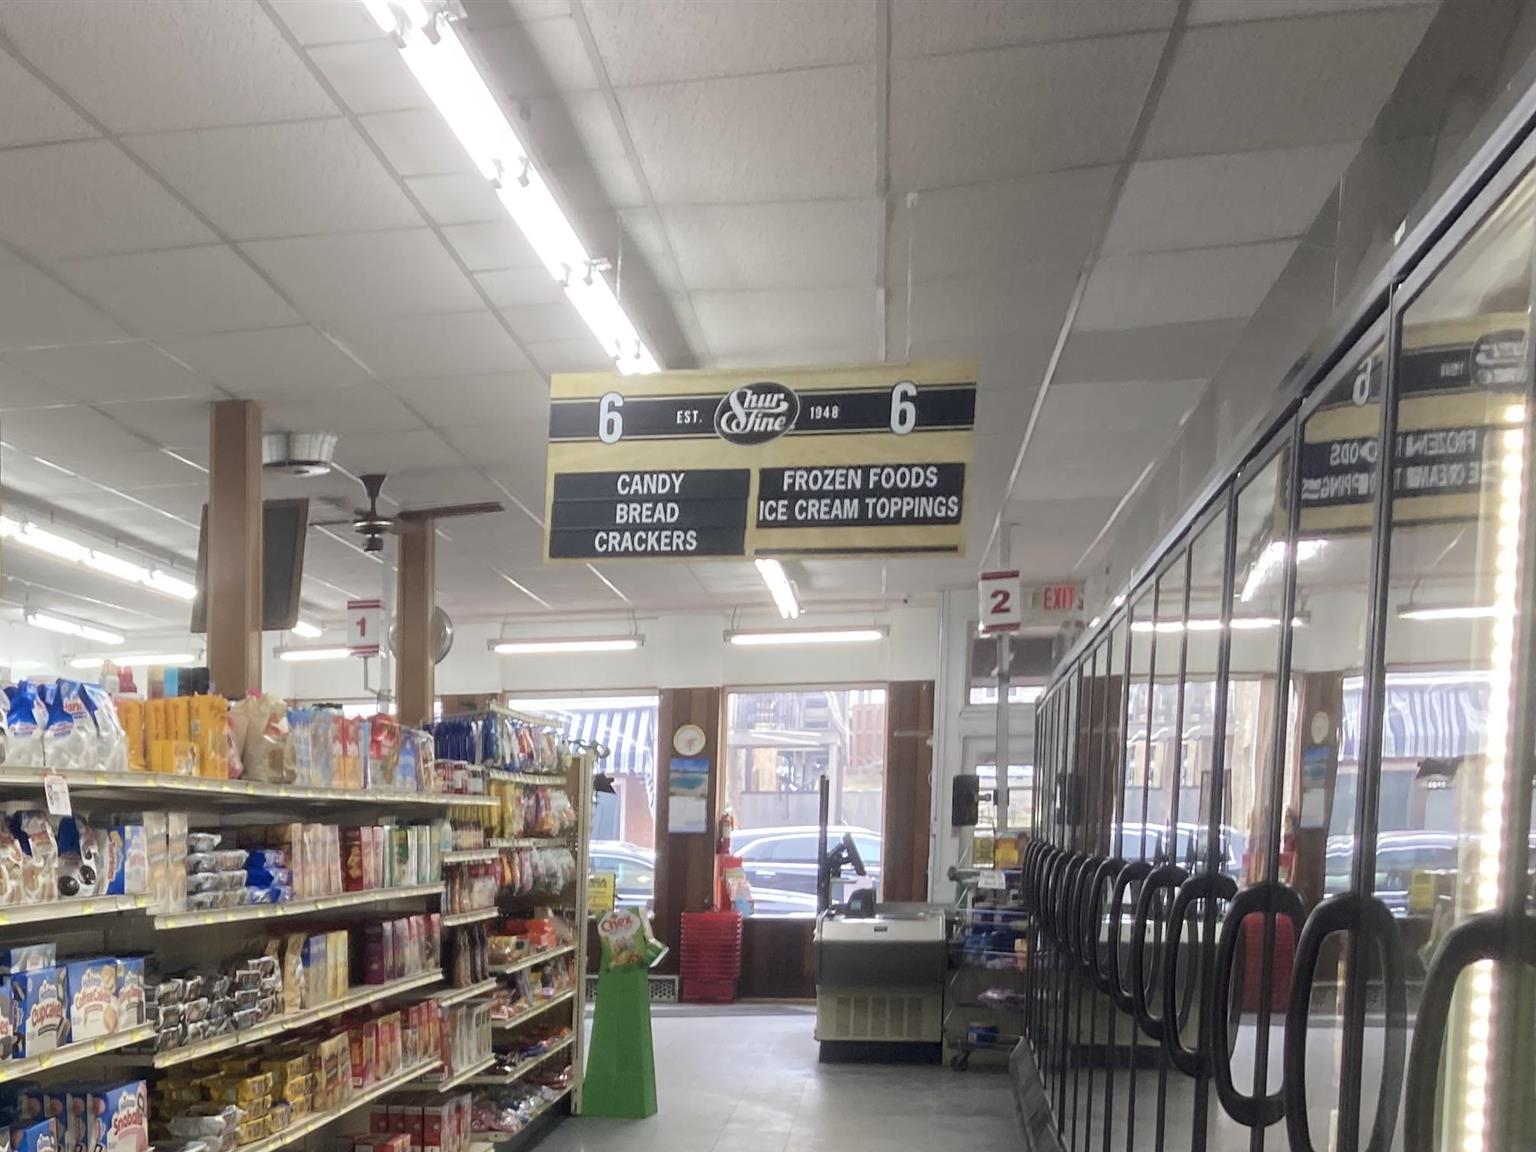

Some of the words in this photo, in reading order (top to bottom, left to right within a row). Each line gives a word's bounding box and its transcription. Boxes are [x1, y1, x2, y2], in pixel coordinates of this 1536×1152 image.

[599, 392, 623, 443] 6
[676, 409, 703, 424] EST.
[810, 405, 839, 420] 1948
[890, 381, 917, 434] 6
[616, 473, 685, 495] CANDY
[783, 469, 862, 491] FROZEN
[868, 466, 938, 489] FOODS
[615, 502, 679, 524] BREAD
[759, 500, 787, 521] ICE
[794, 499, 859, 521] CREAM
[864, 496, 958, 519] TOPPINGS
[594, 530, 697, 553] CRACKERS
[990, 590, 1011, 614] 2
[1043, 587, 1076, 610] EXIT
[356, 617, 366, 637] 1
